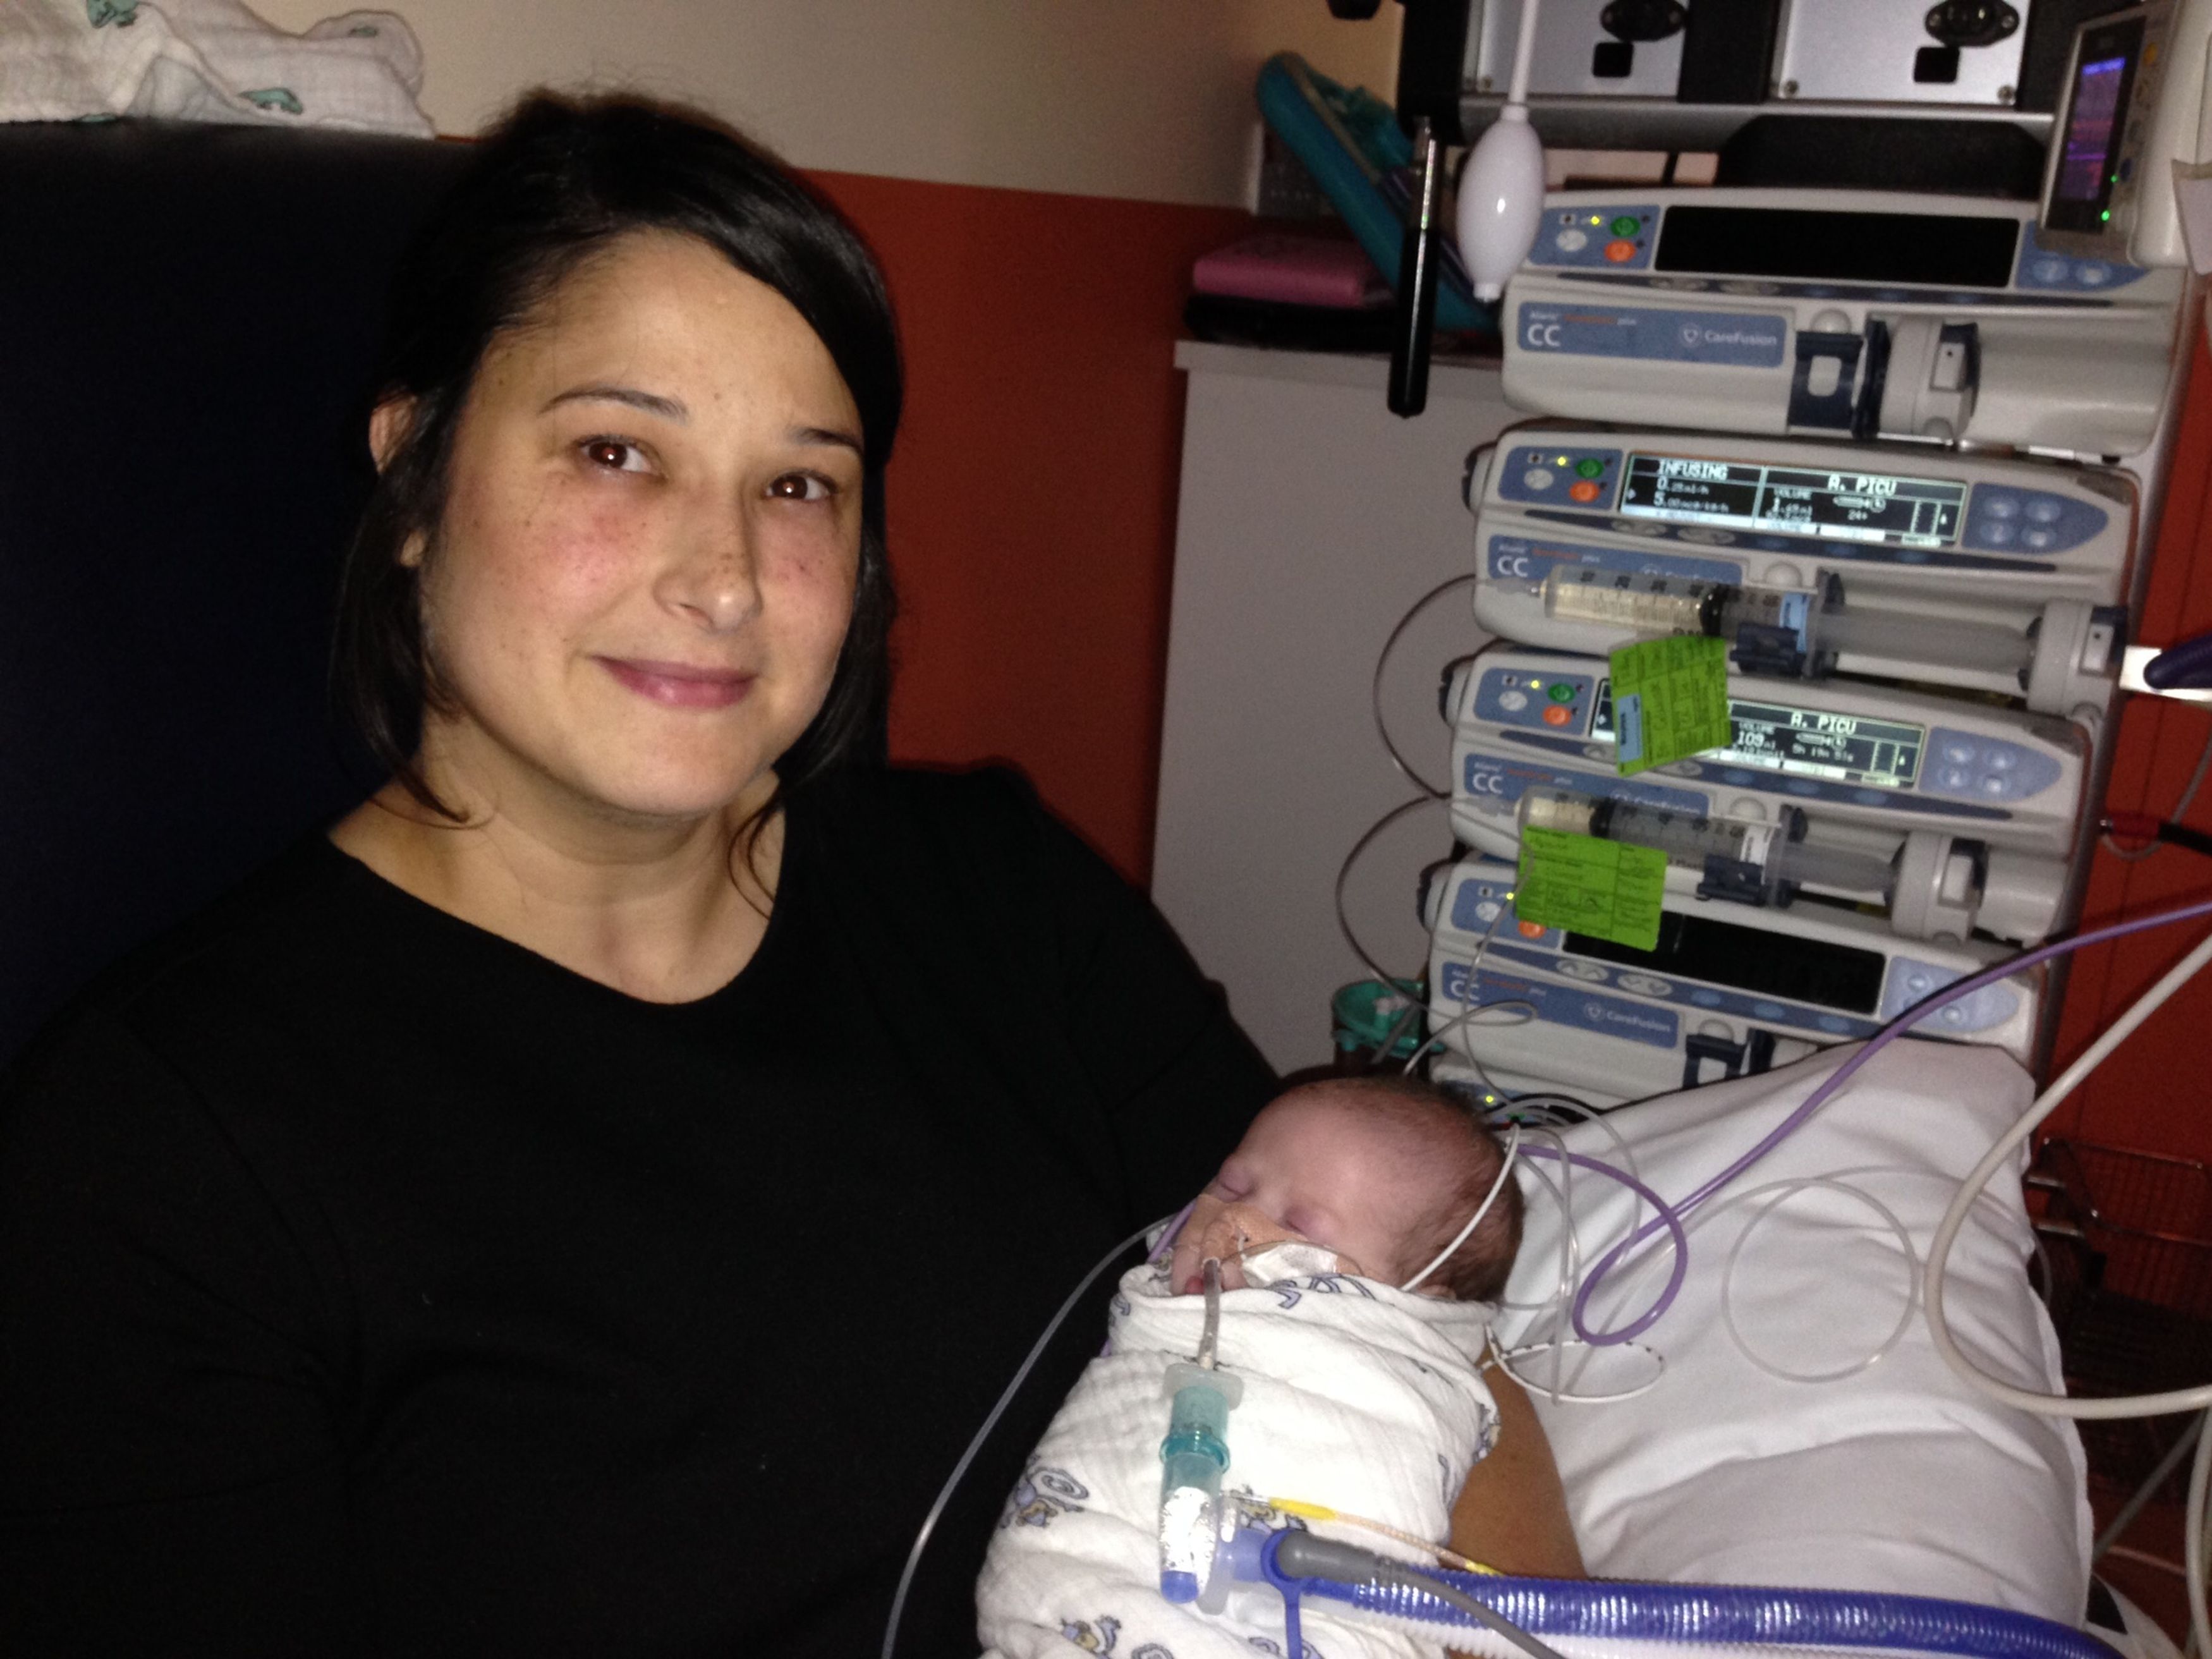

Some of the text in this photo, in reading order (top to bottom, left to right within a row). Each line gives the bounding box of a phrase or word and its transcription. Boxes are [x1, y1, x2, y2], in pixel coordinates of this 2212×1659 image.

[1527, 324, 1562, 347] CC
[1705, 330, 1777, 346] CareFusion
[1658, 459, 1729, 481] INFUSING
[1855, 475, 1897, 497] PICU
[1497, 555, 1529, 578] CC
[1817, 714, 1857, 735] PICU
[1473, 772, 1504, 795] CC
